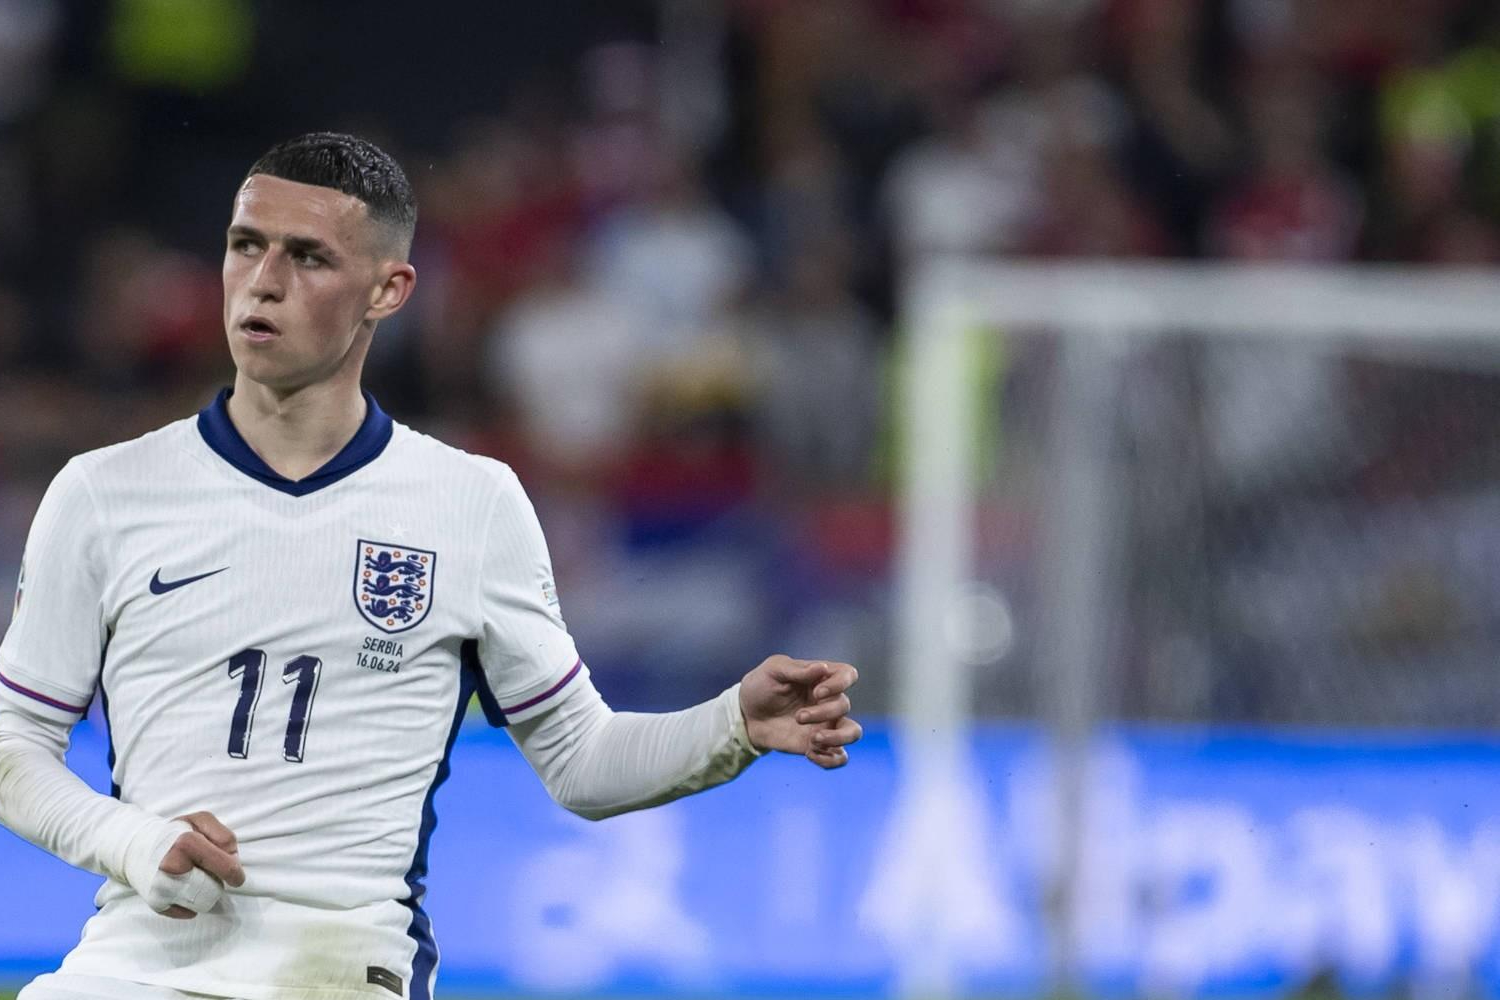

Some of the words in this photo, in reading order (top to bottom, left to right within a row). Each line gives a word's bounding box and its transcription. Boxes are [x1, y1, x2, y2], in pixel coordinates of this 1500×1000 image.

[362, 636, 403, 658] SERBIA
[357, 652, 401, 674] 16.06.24
[228, 648, 323, 763] 11
